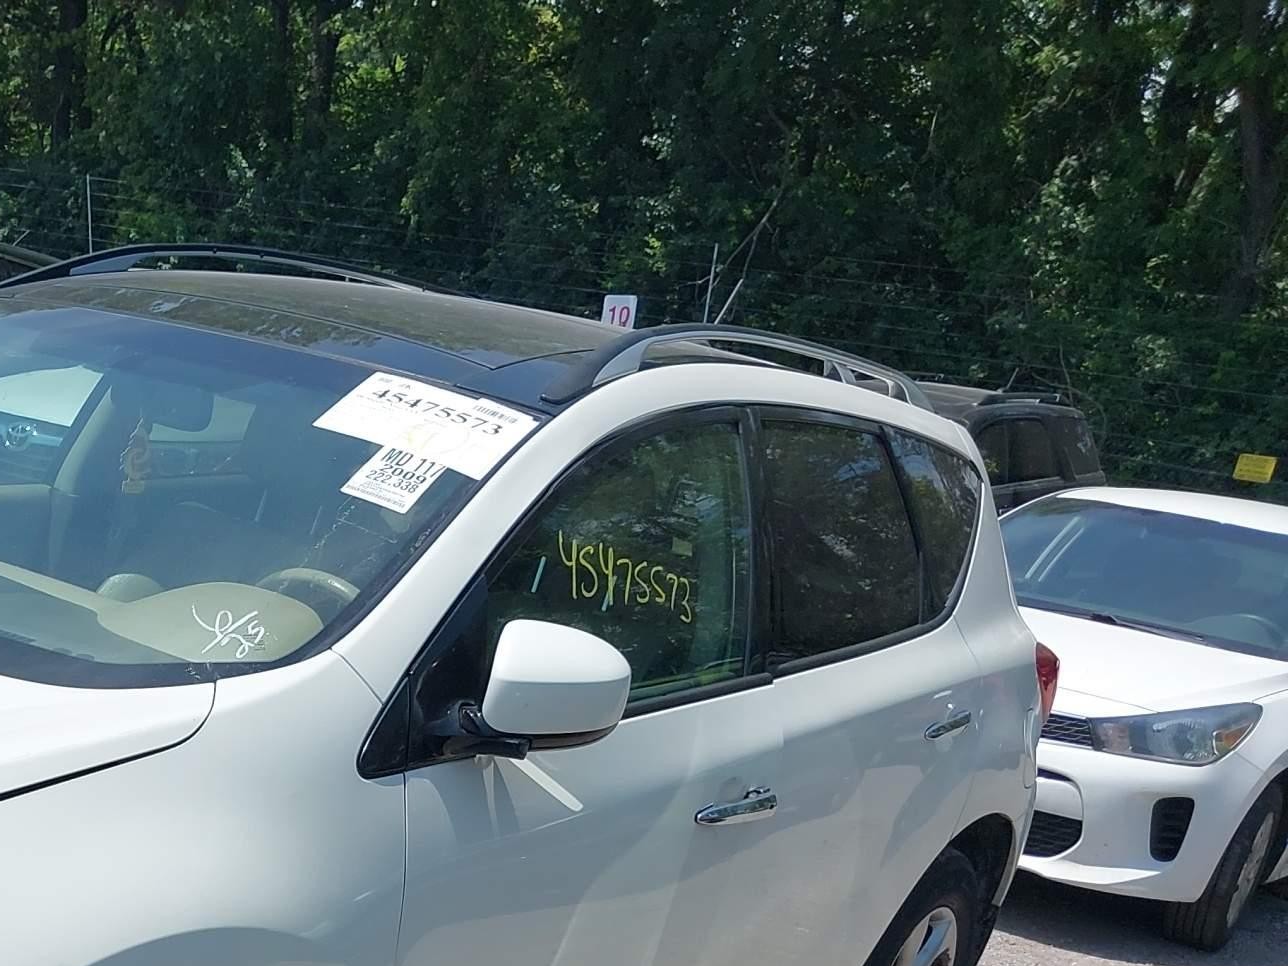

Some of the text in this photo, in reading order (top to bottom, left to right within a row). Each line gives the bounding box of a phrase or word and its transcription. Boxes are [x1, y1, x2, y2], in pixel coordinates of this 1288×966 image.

[608, 305, 631, 328] 10
[372, 388, 504, 436] 45475573
[379, 463, 427, 485] 2009
[558, 528, 692, 624] 45475573
